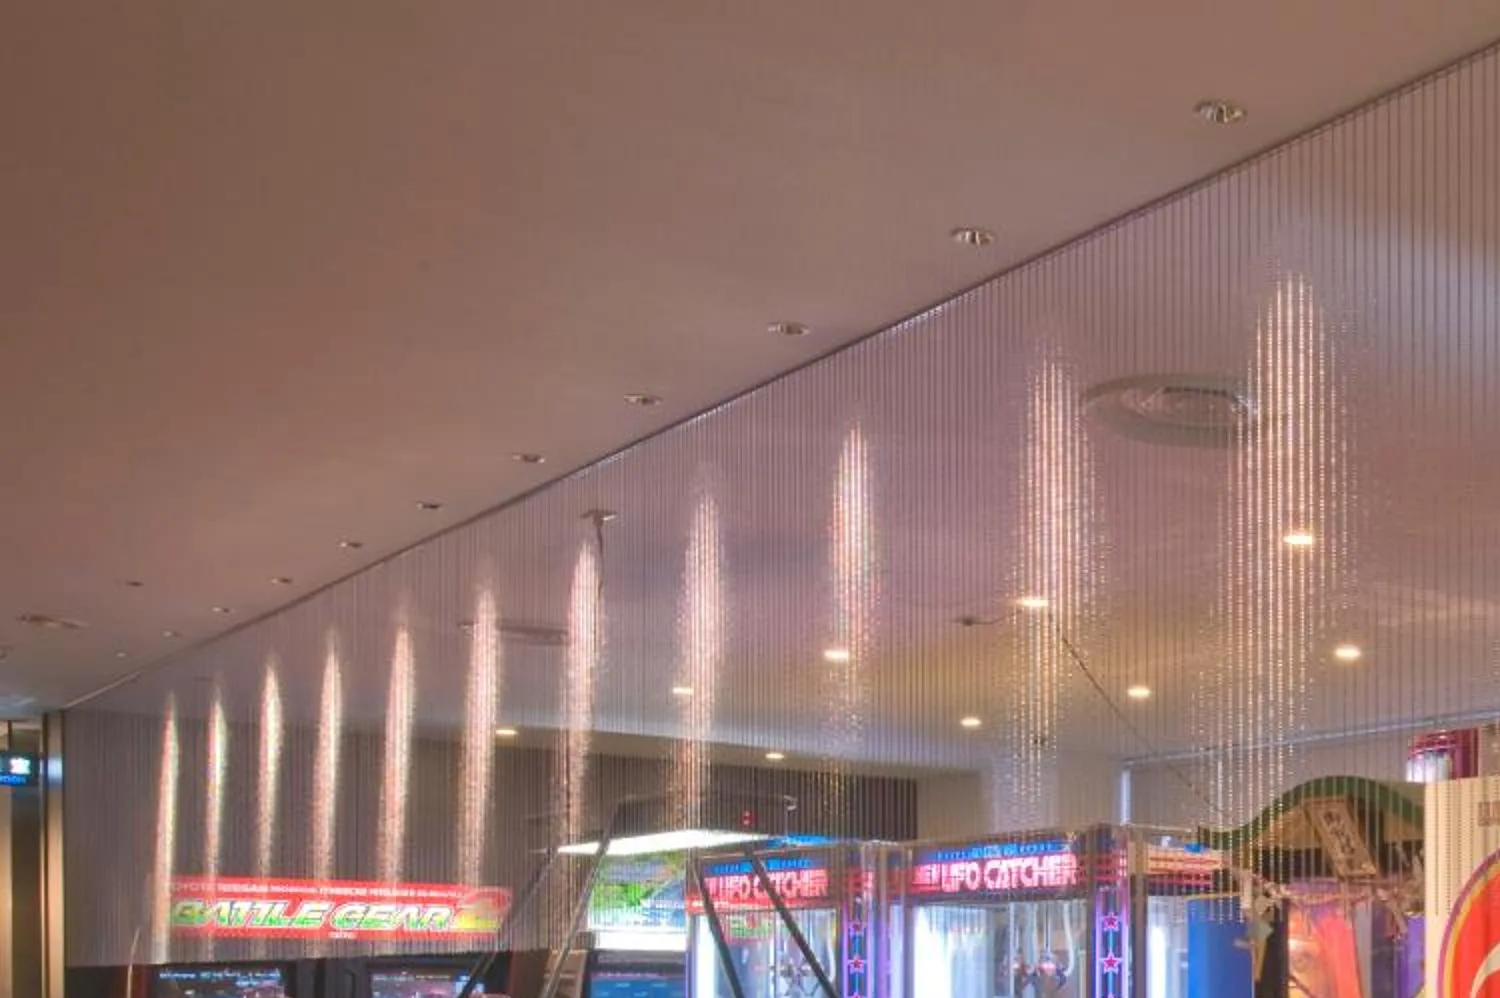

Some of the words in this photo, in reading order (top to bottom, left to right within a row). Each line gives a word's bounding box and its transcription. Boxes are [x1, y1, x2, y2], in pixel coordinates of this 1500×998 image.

[753, 869, 829, 899] CTCHER
[941, 860, 980, 892] UFO
[983, 853, 1078, 890] CATCHER
[171, 899, 332, 929] BATTLE
[330, 901, 454, 932] GEAR
